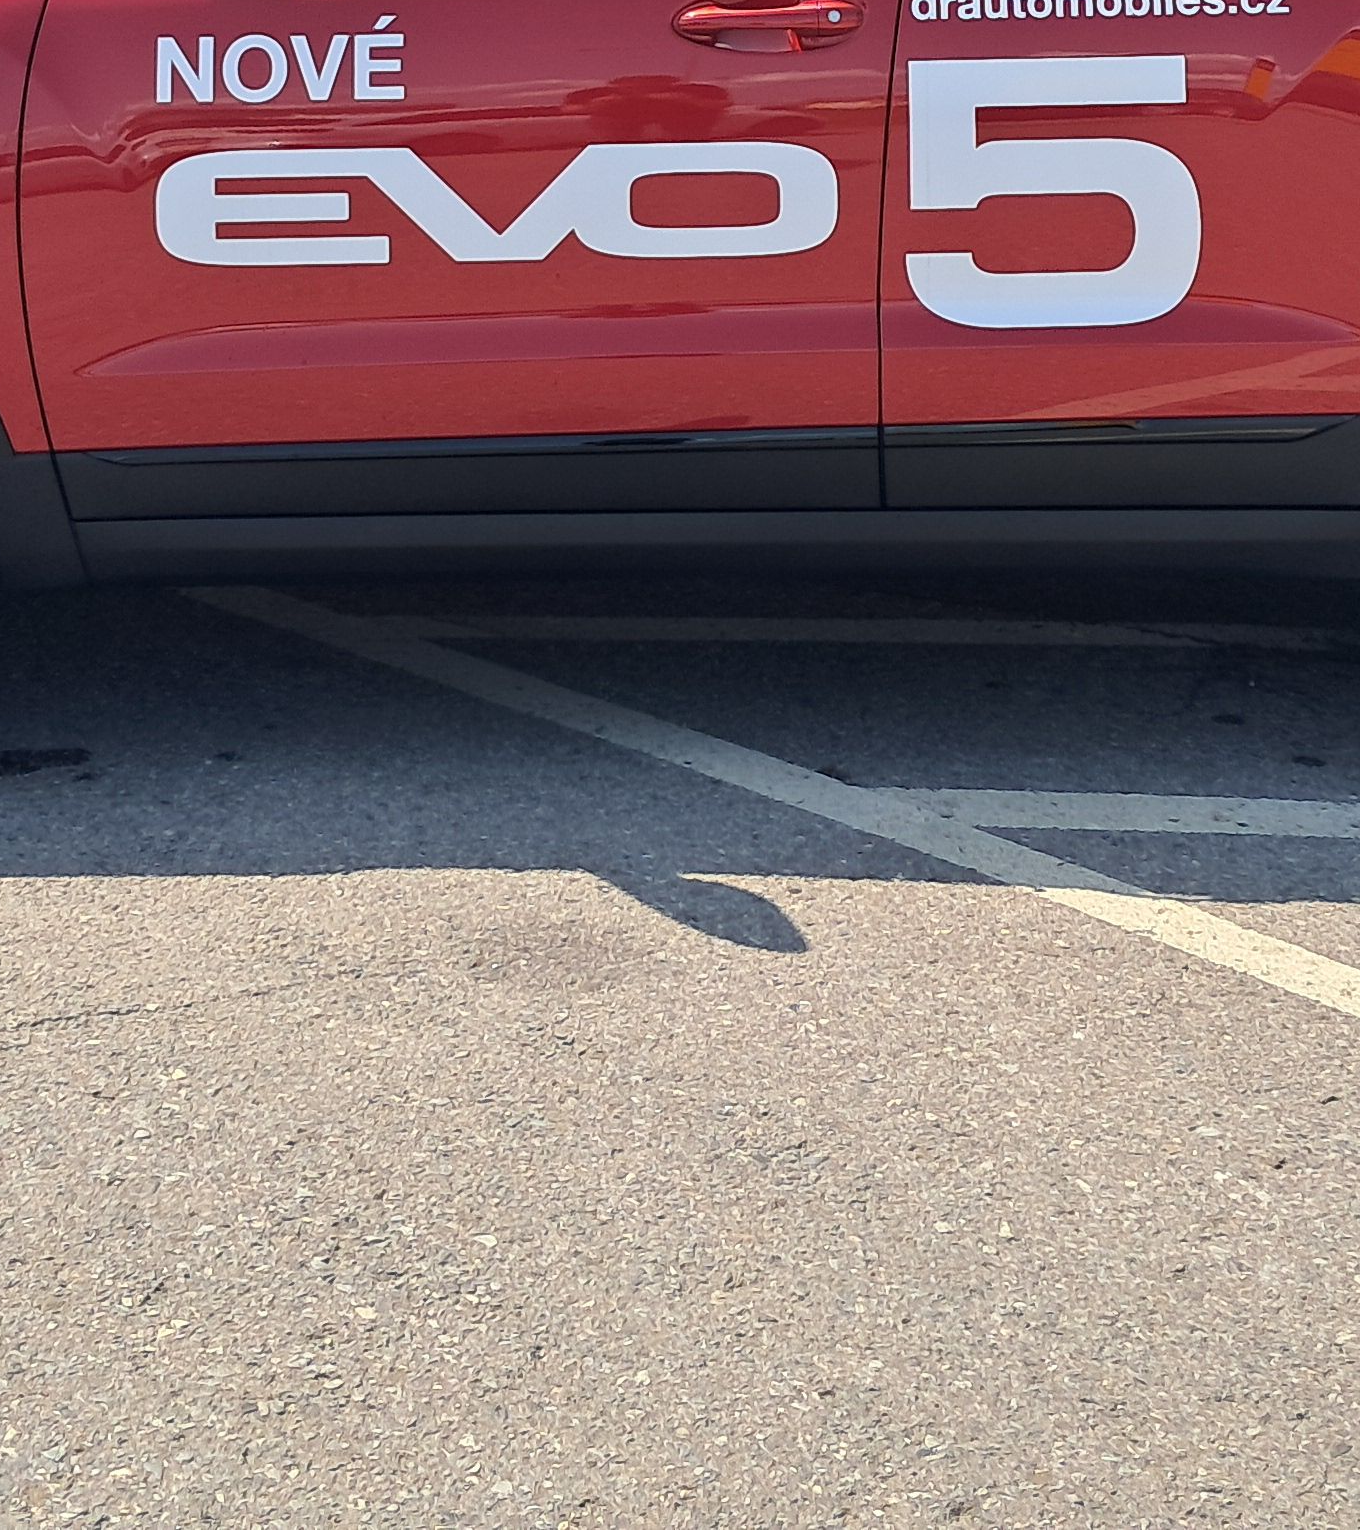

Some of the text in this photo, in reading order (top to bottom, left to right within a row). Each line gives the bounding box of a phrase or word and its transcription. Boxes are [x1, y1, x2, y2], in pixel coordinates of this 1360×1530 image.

[156, 15, 406, 103] NOVÉ
[155, 54, 1202, 329] EVO 5
